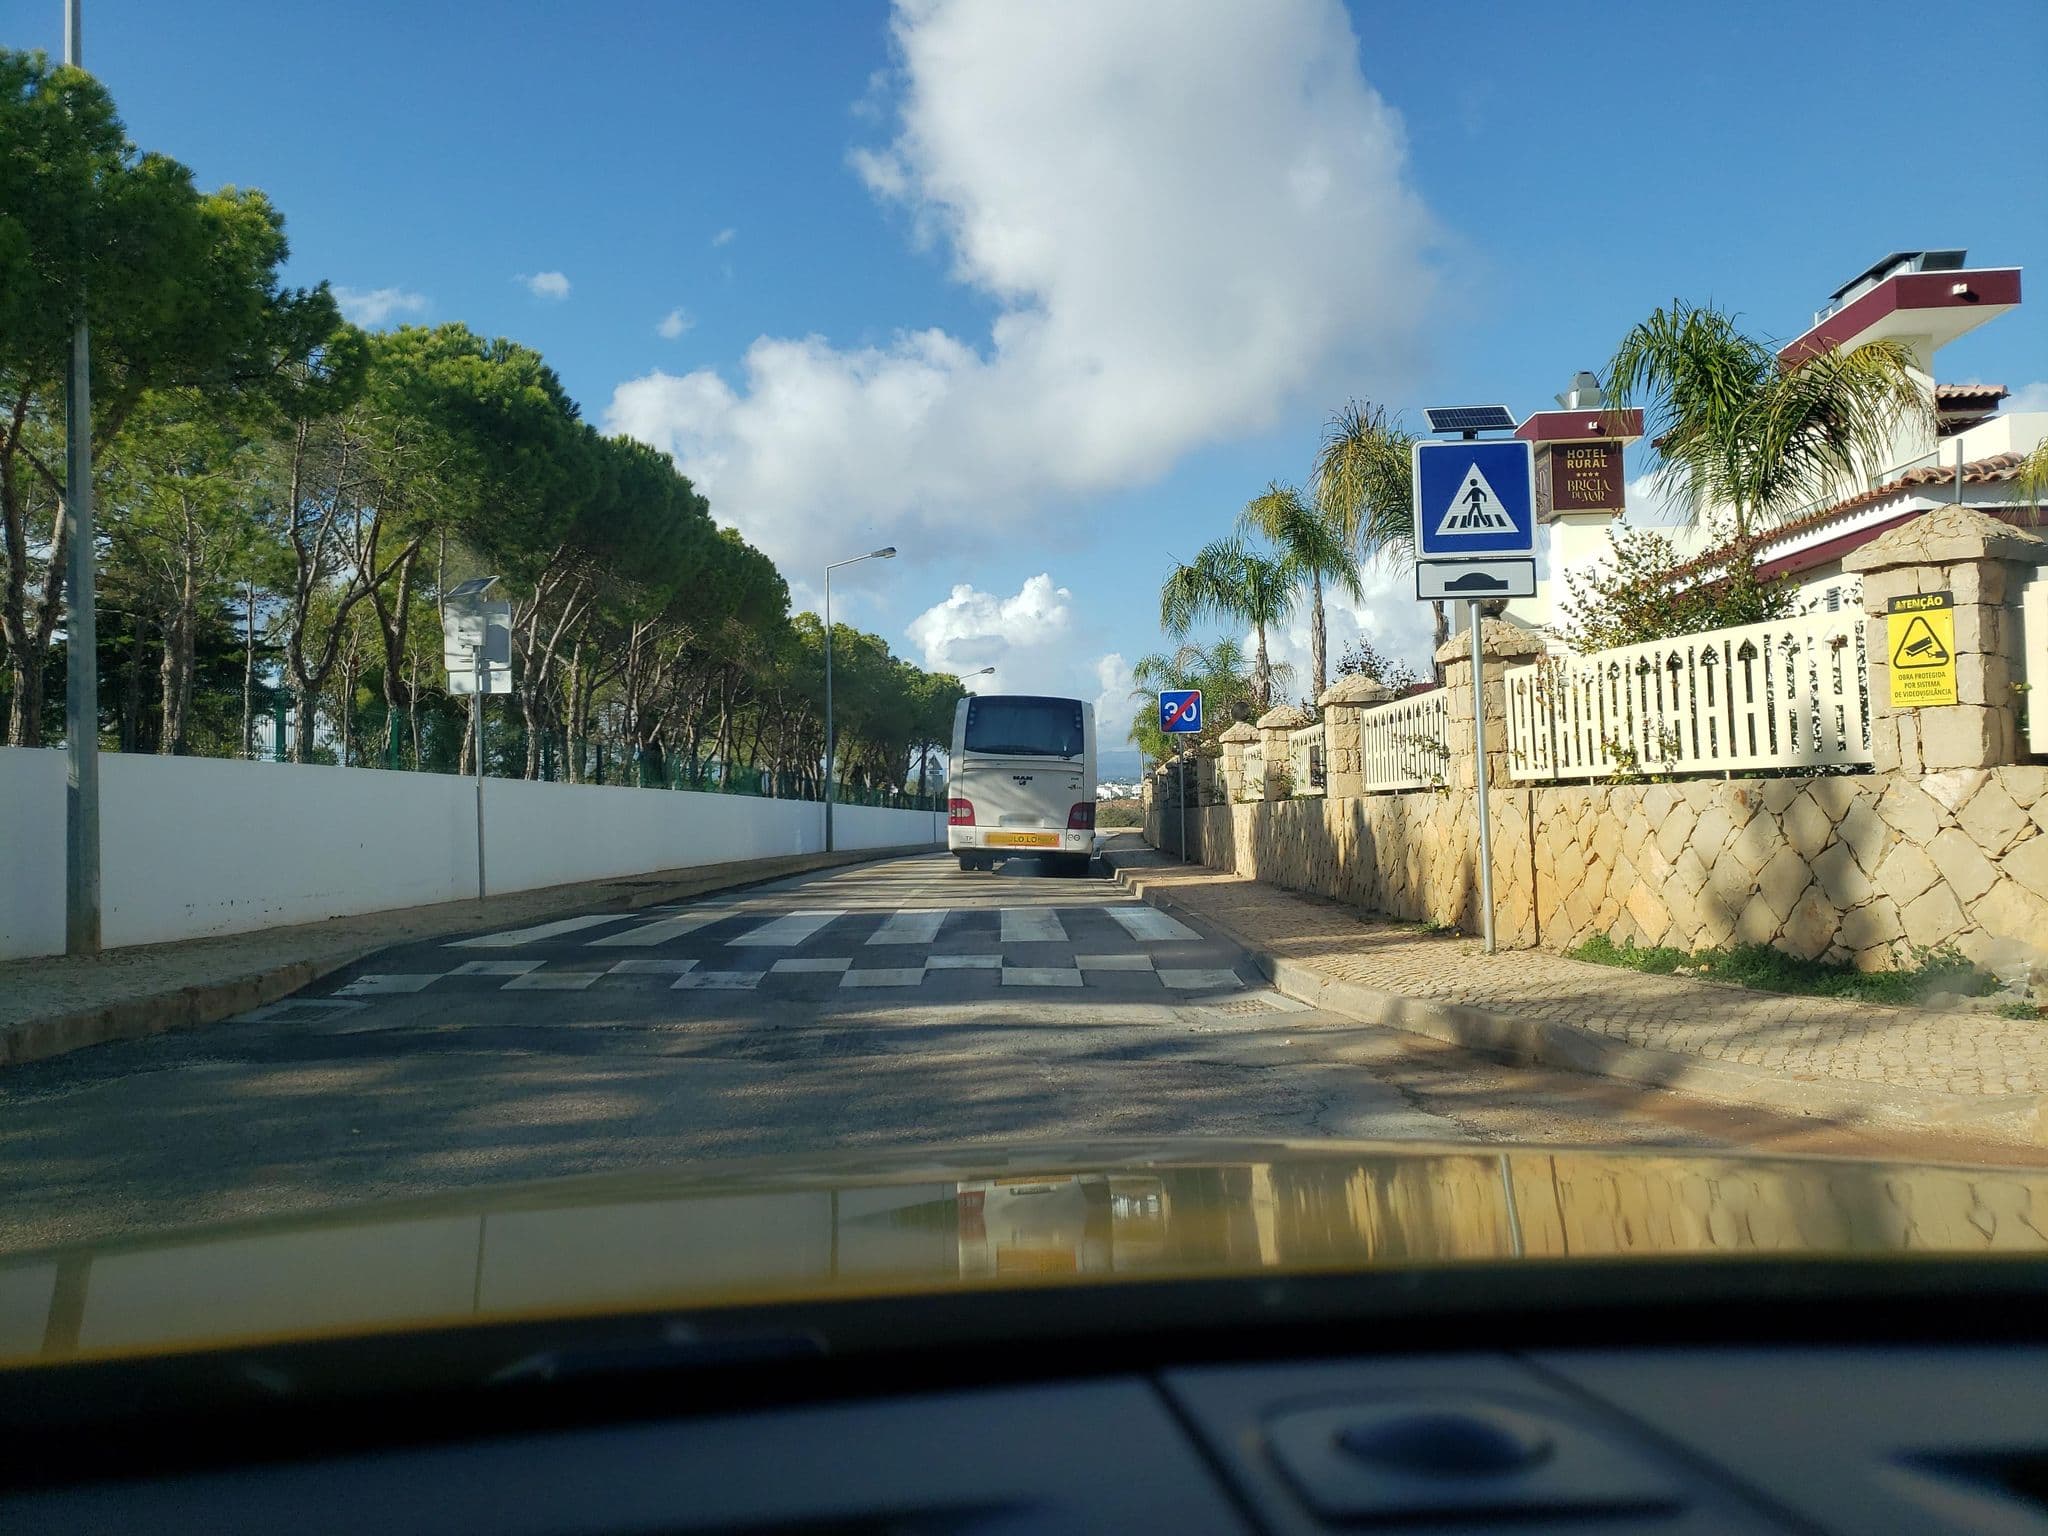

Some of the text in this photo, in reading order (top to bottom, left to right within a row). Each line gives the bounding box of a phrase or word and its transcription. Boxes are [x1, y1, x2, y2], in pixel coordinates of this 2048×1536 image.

[1567, 448, 1608, 459] HOTEL
[1567, 458, 1608, 469] RURAL
[1894, 594, 1944, 611] ATENÇÃO
[1898, 671, 1947, 681] OBRA PROTEGIDA
[1917, 680, 1941, 688] SISTEMA
[1903, 687, 1952, 698] VIDEOVIGILÂNCIA
[1164, 701, 1197, 722] 30
